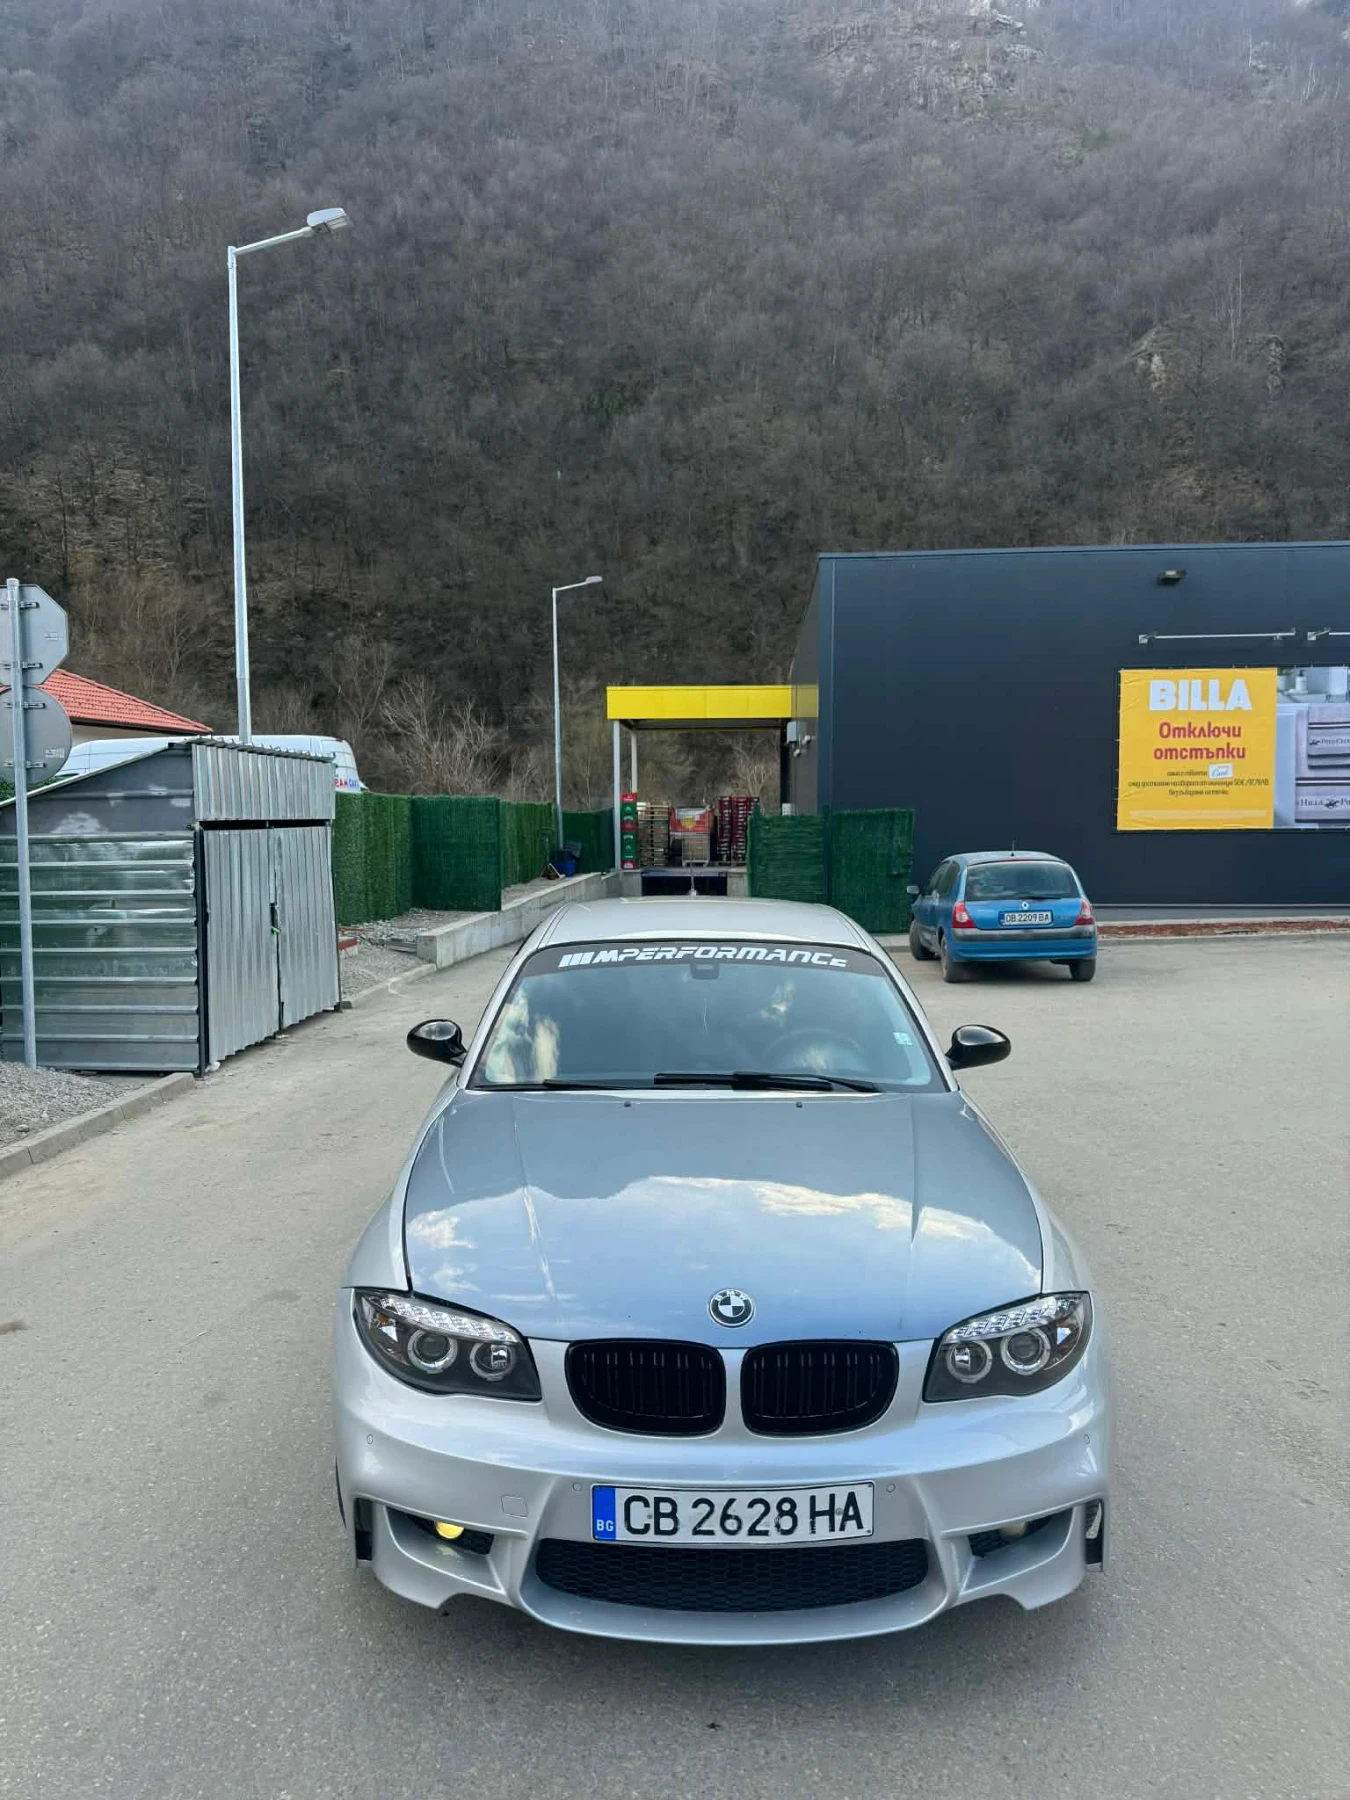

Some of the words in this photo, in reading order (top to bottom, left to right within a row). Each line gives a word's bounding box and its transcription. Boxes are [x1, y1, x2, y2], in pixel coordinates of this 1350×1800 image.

[1149, 680, 1252, 711] BILLA
[1159, 721, 1241, 739] Отключи
[1153, 742, 1246, 760] отстъпки
[623, 1495, 679, 1536] CB
[691, 1496, 798, 1536] 2628
[809, 1491, 864, 1535] HA
[596, 1519, 614, 1532] BG
